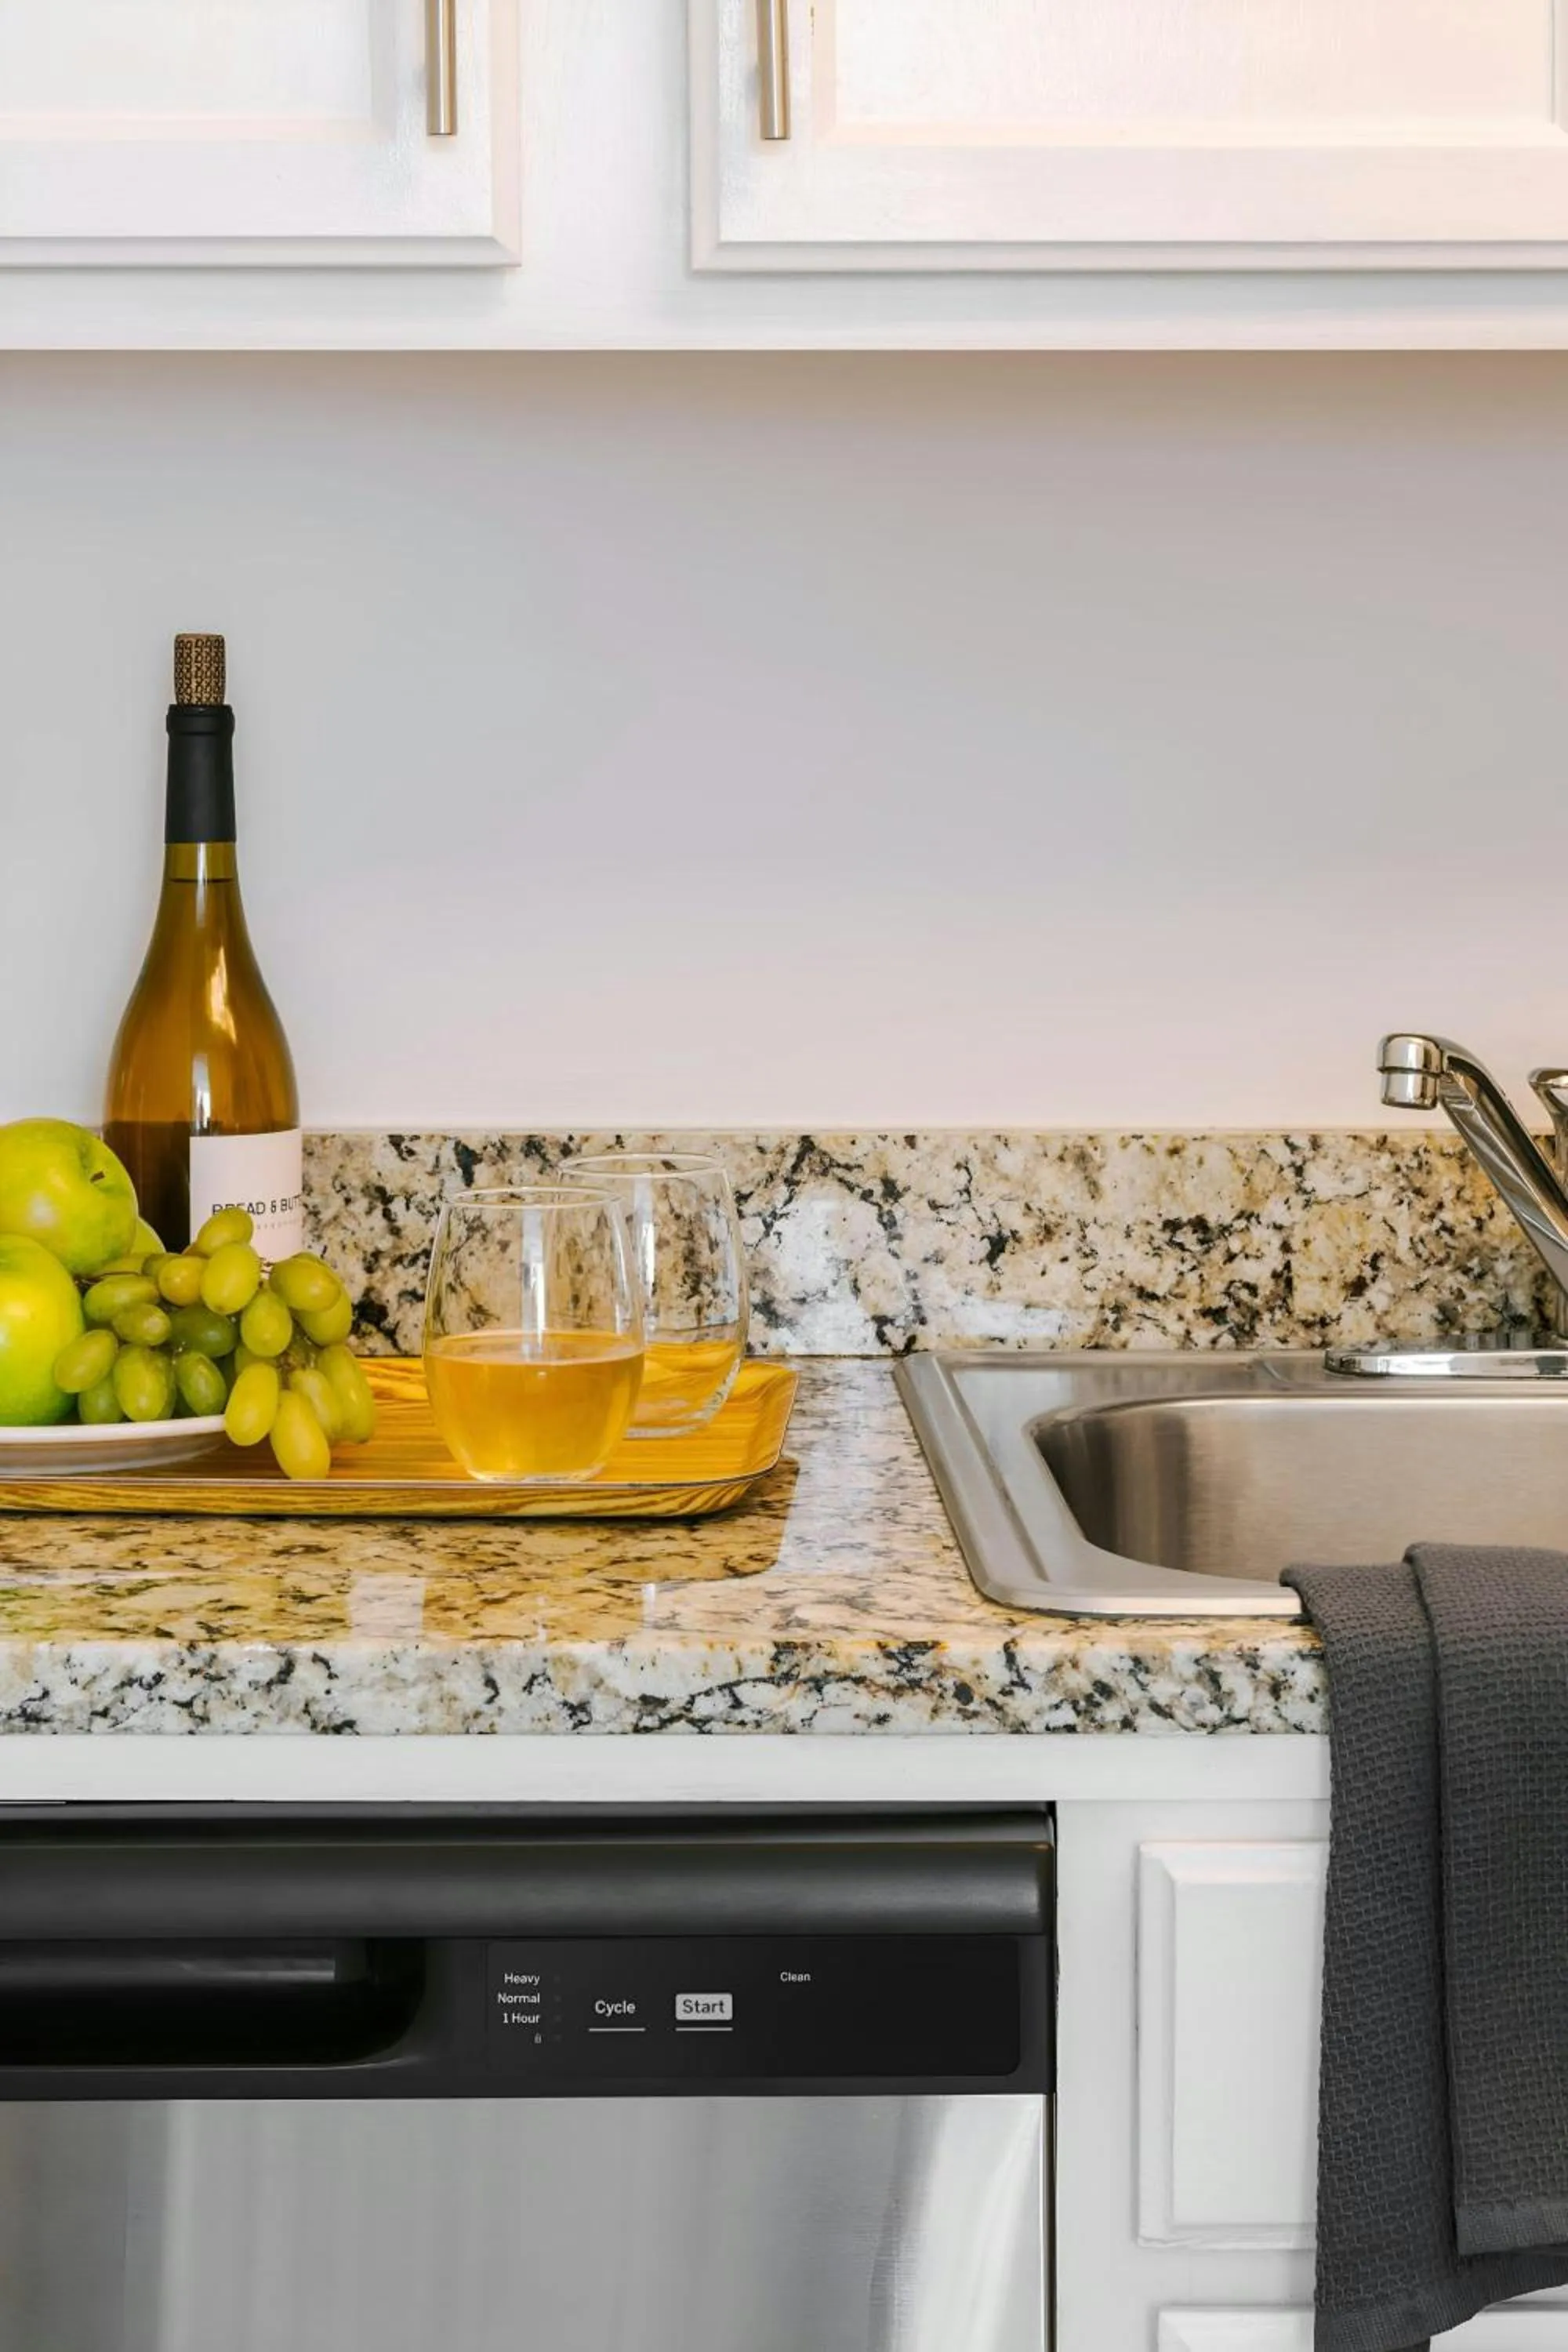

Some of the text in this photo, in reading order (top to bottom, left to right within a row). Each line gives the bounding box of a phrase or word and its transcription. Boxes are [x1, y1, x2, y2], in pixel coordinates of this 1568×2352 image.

[504, 1972, 540, 1986] Heavy
[780, 1971, 811, 1982] Clean
[497, 1992, 540, 2004] Normal
[594, 1999, 636, 2017] Cycle
[682, 1998, 725, 2014] Start
[503, 2012, 541, 2024] 1 Hour
